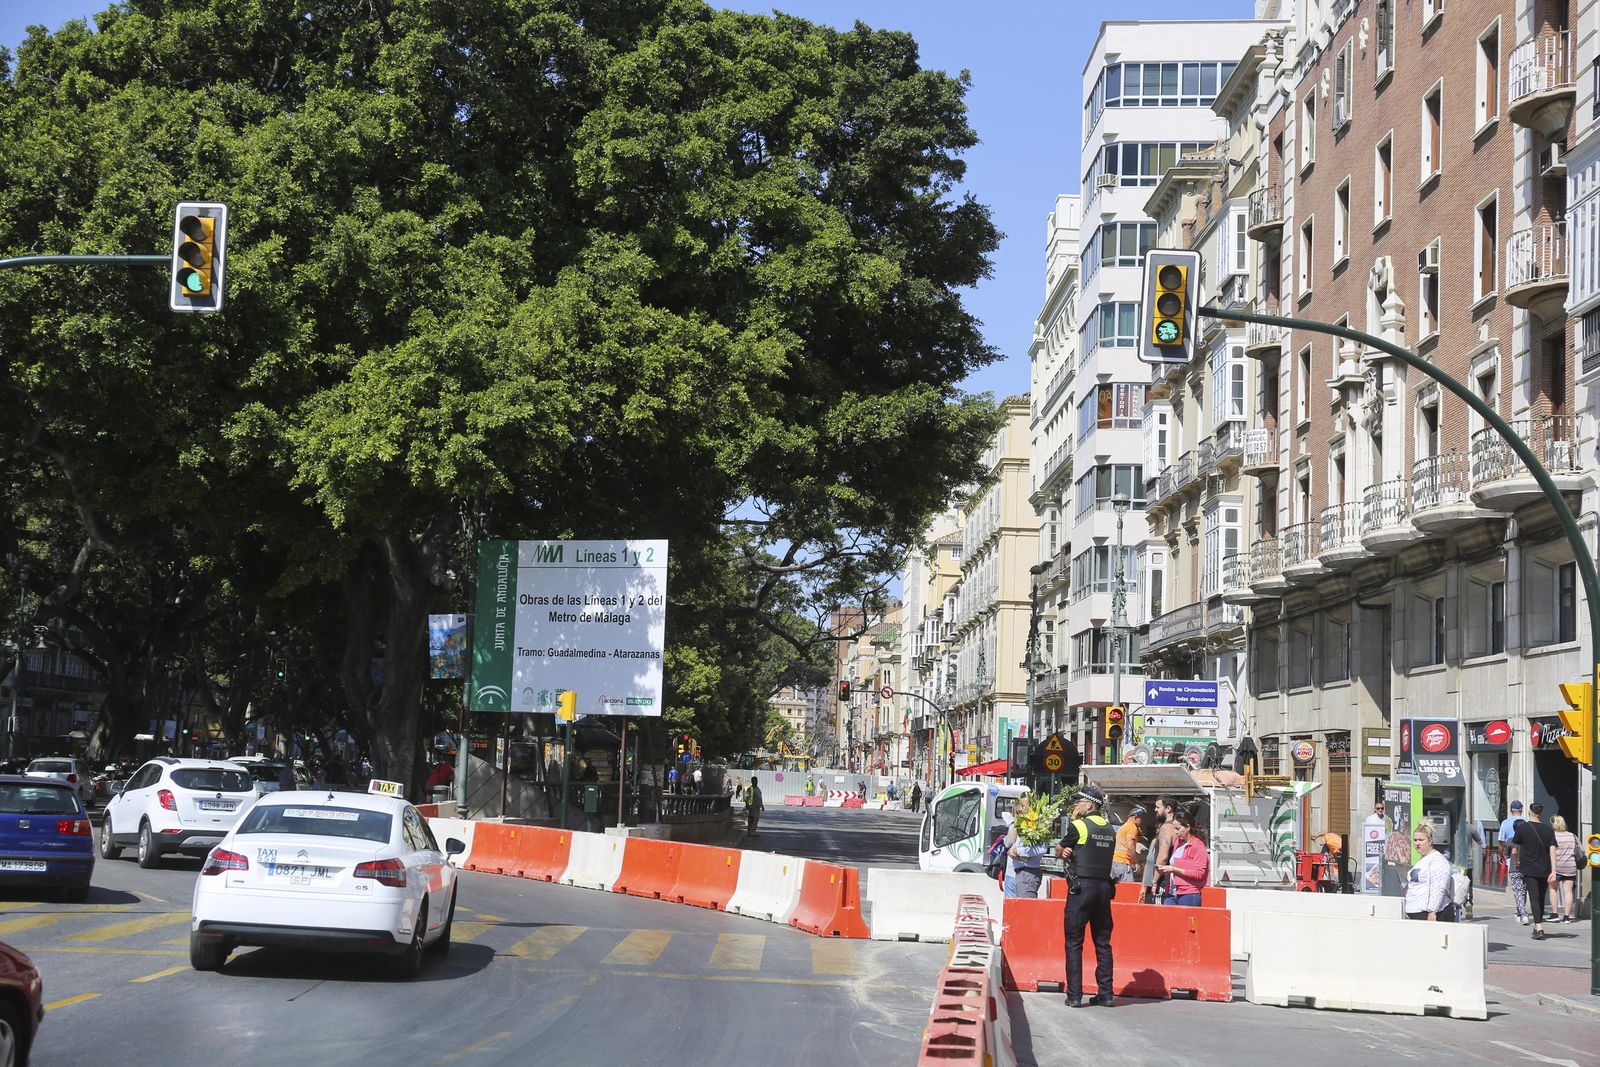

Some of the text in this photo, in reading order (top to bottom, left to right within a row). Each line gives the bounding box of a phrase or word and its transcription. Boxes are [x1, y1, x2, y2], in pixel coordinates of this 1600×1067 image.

[576, 547, 654, 566] Líneas 1 y 2
[520, 593, 663, 608] Obras de las Líneas 1 y 2 del
[496, 606, 507, 618] DE
[549, 611, 631, 626] Metro de Málaga
[494, 622, 506, 651] JUNTA
[517, 646, 546, 658] Tramo:
[547, 647, 606, 659] Guadalmedina
[613, 648, 660, 660] Atarazanas
[1047, 758, 1060, 767] 30
[1419, 759, 1456, 767] BUFFET
[380, 782, 397, 794] TAXI
[257, 847, 278, 857] TAXI
[275, 865, 332, 878] 0871 JML
